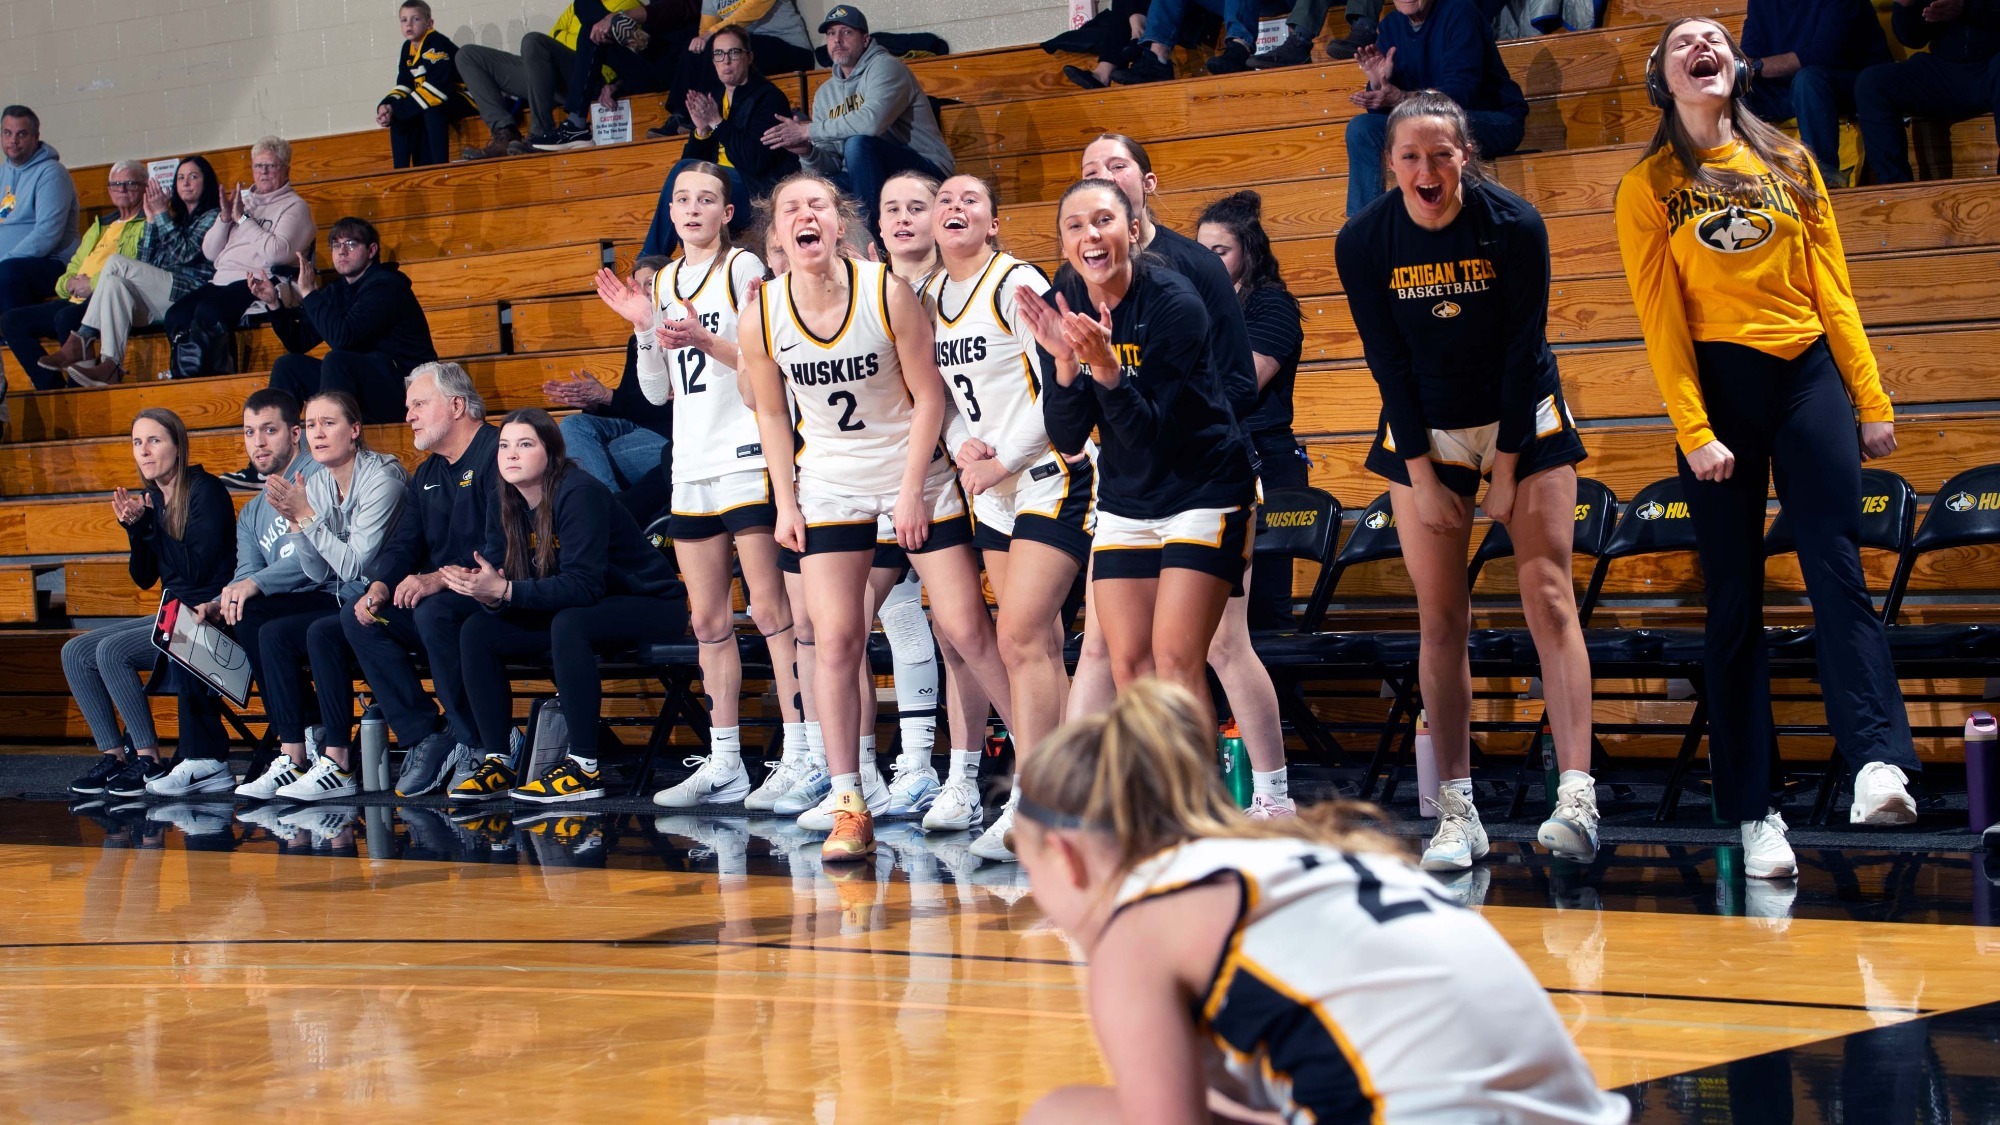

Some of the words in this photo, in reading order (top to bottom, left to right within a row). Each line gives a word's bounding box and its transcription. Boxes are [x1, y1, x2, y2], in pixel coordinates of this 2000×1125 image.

[1397, 280, 1490, 300] BASKETBALL
[934, 335, 987, 368] USKIES
[677, 347, 707, 396] 12
[790, 352, 879, 386] HUSKIES
[827, 390, 867, 432] 2
[953, 373, 982, 423] 3
[1574, 504, 1591, 520] ES
[1664, 502, 1691, 519] HU
[1861, 495, 1890, 513] IES
[1265, 510, 1319, 528] HUSKIES
